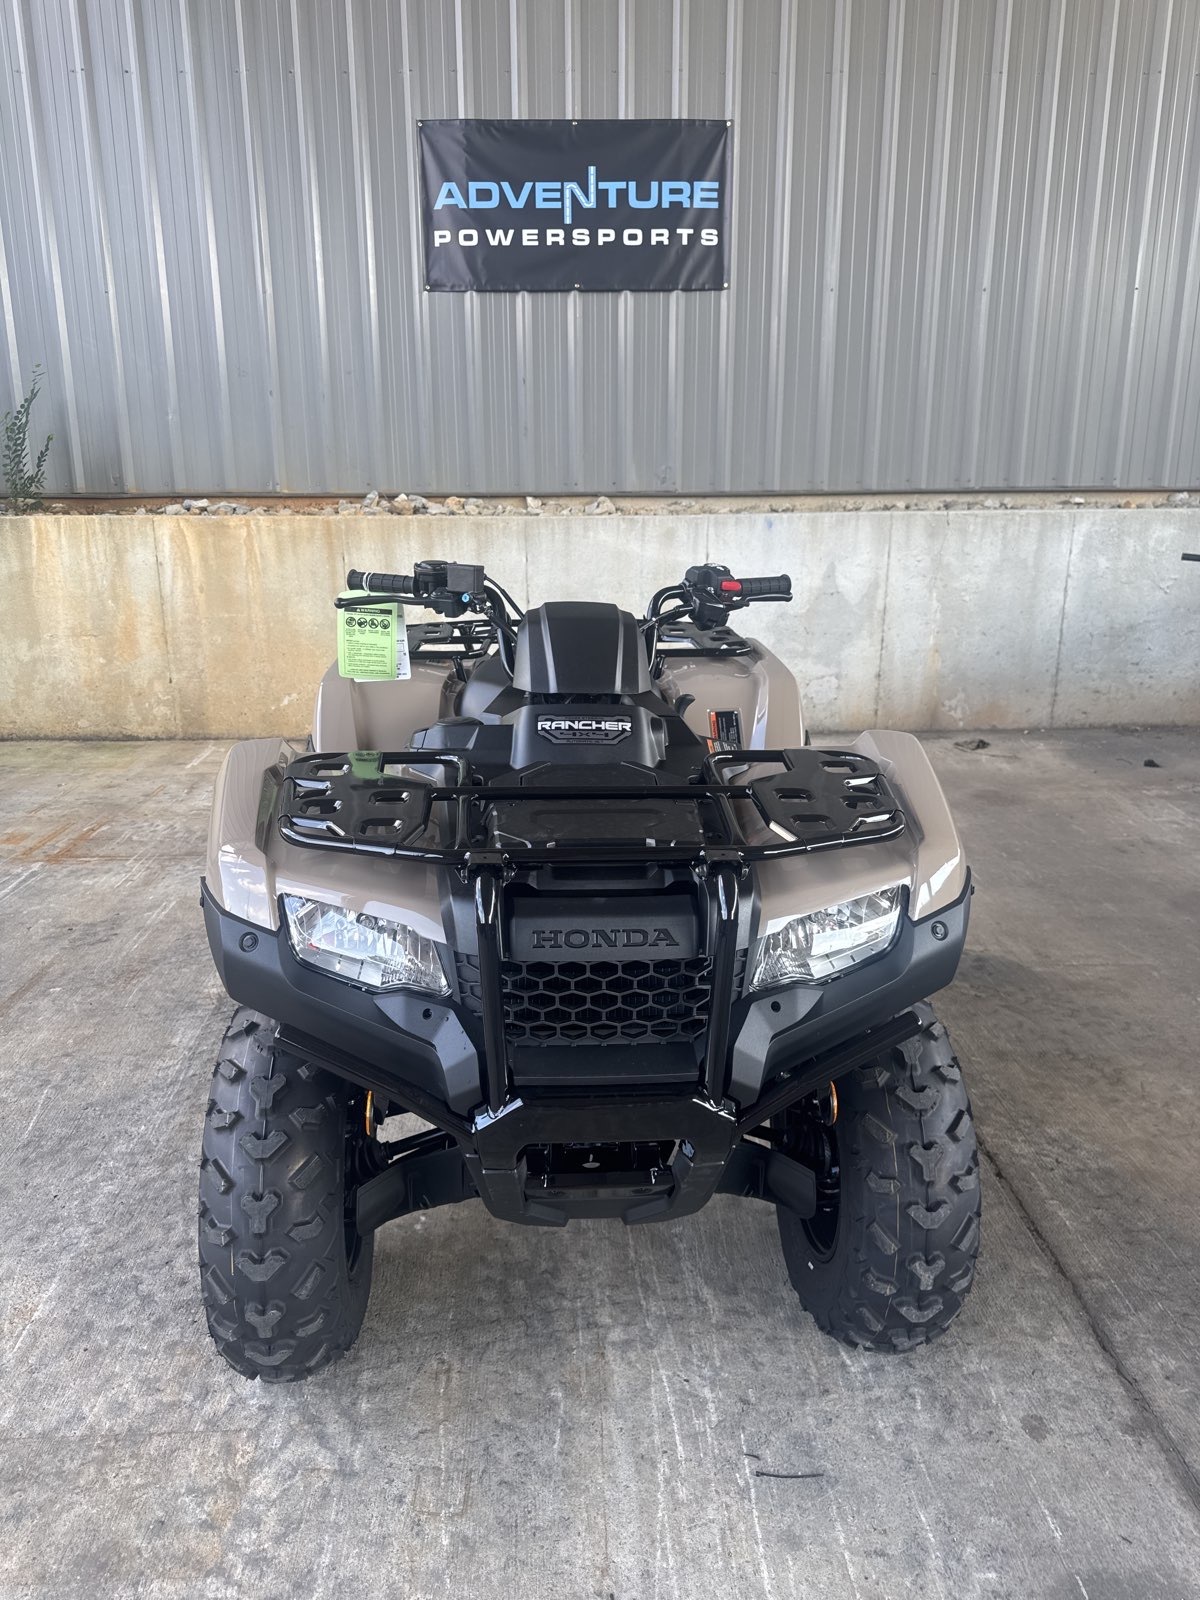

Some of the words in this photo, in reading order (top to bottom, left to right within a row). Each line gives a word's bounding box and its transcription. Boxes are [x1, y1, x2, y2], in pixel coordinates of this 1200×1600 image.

[433, 166, 719, 224] ADVENTURE
[433, 228, 719, 247] POWERSPORTS
[538, 720, 632, 731] RANCHER
[532, 928, 680, 949] HONDA
